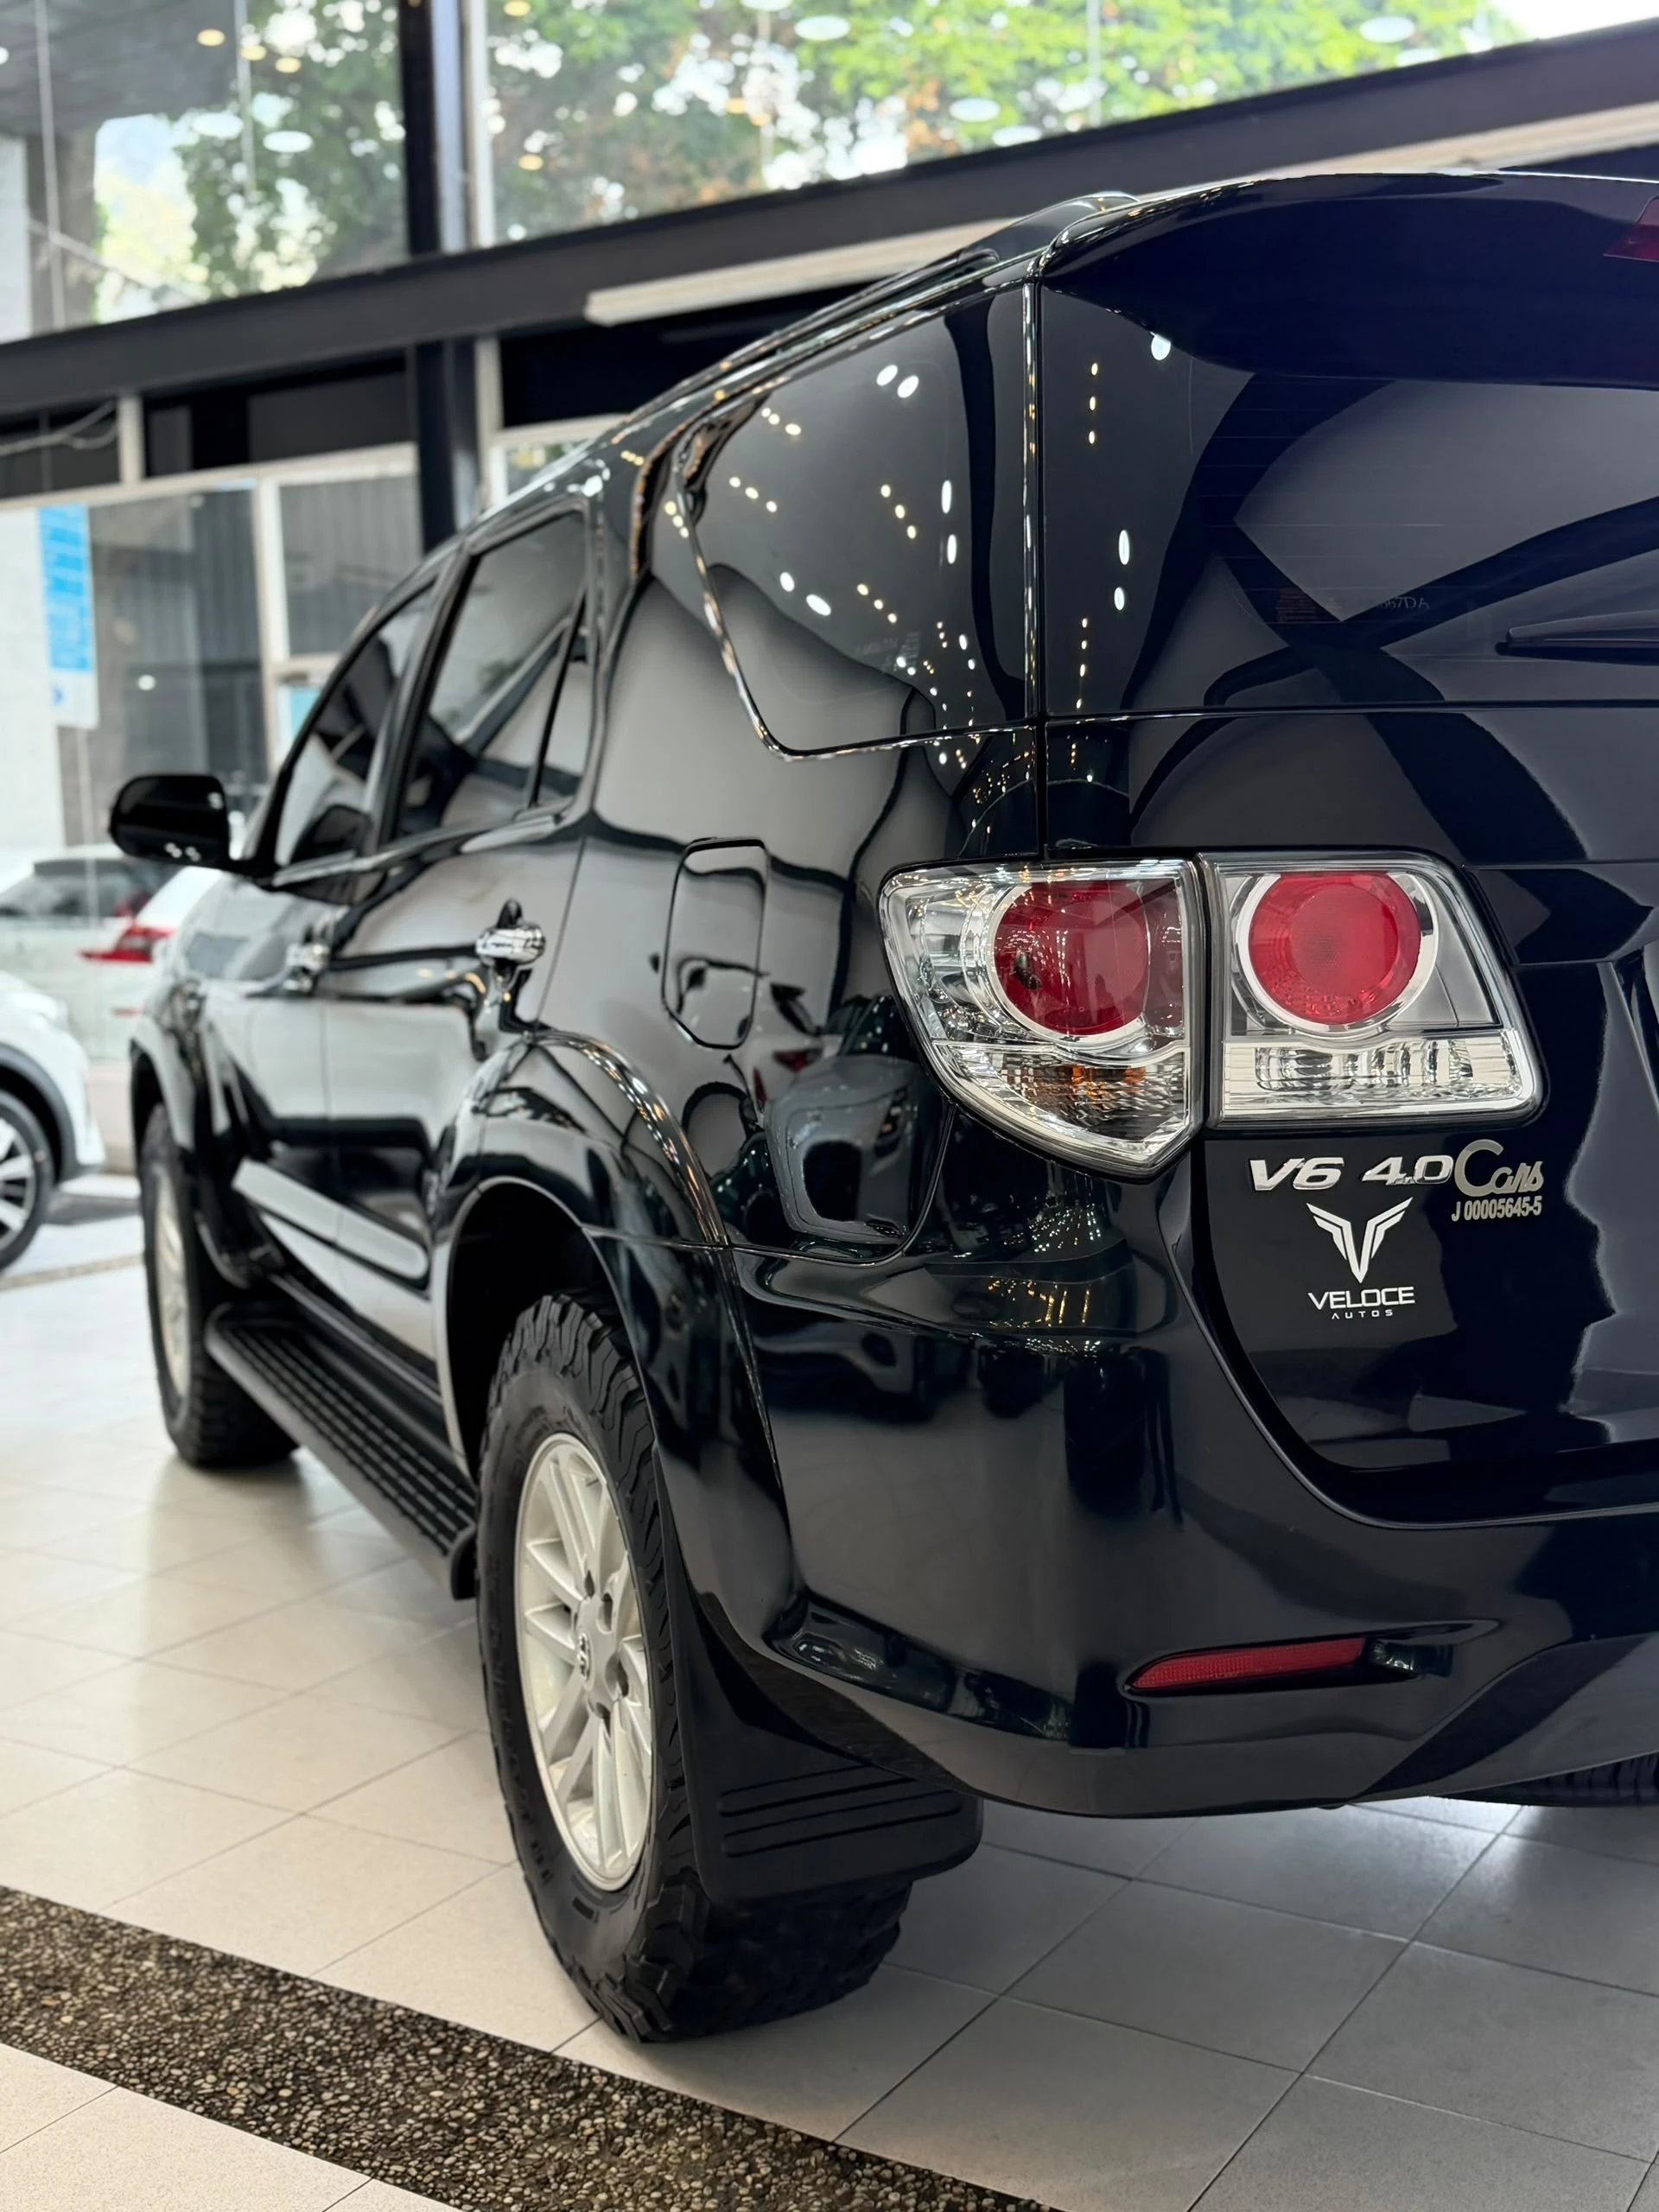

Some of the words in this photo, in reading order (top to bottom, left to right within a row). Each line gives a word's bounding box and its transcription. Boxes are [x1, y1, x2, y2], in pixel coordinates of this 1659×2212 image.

[1250, 1157, 1344, 1191] V6
[1362, 1155, 1454, 1185] 4.0
[1454, 1139, 1544, 1198] Cars
[1452, 1201, 1461, 1222] J
[1464, 1196, 1542, 1221] 00005645-5
[1307, 1286, 1415, 1310] VELOCE
[1332, 1309, 1393, 1320] AUTOS
